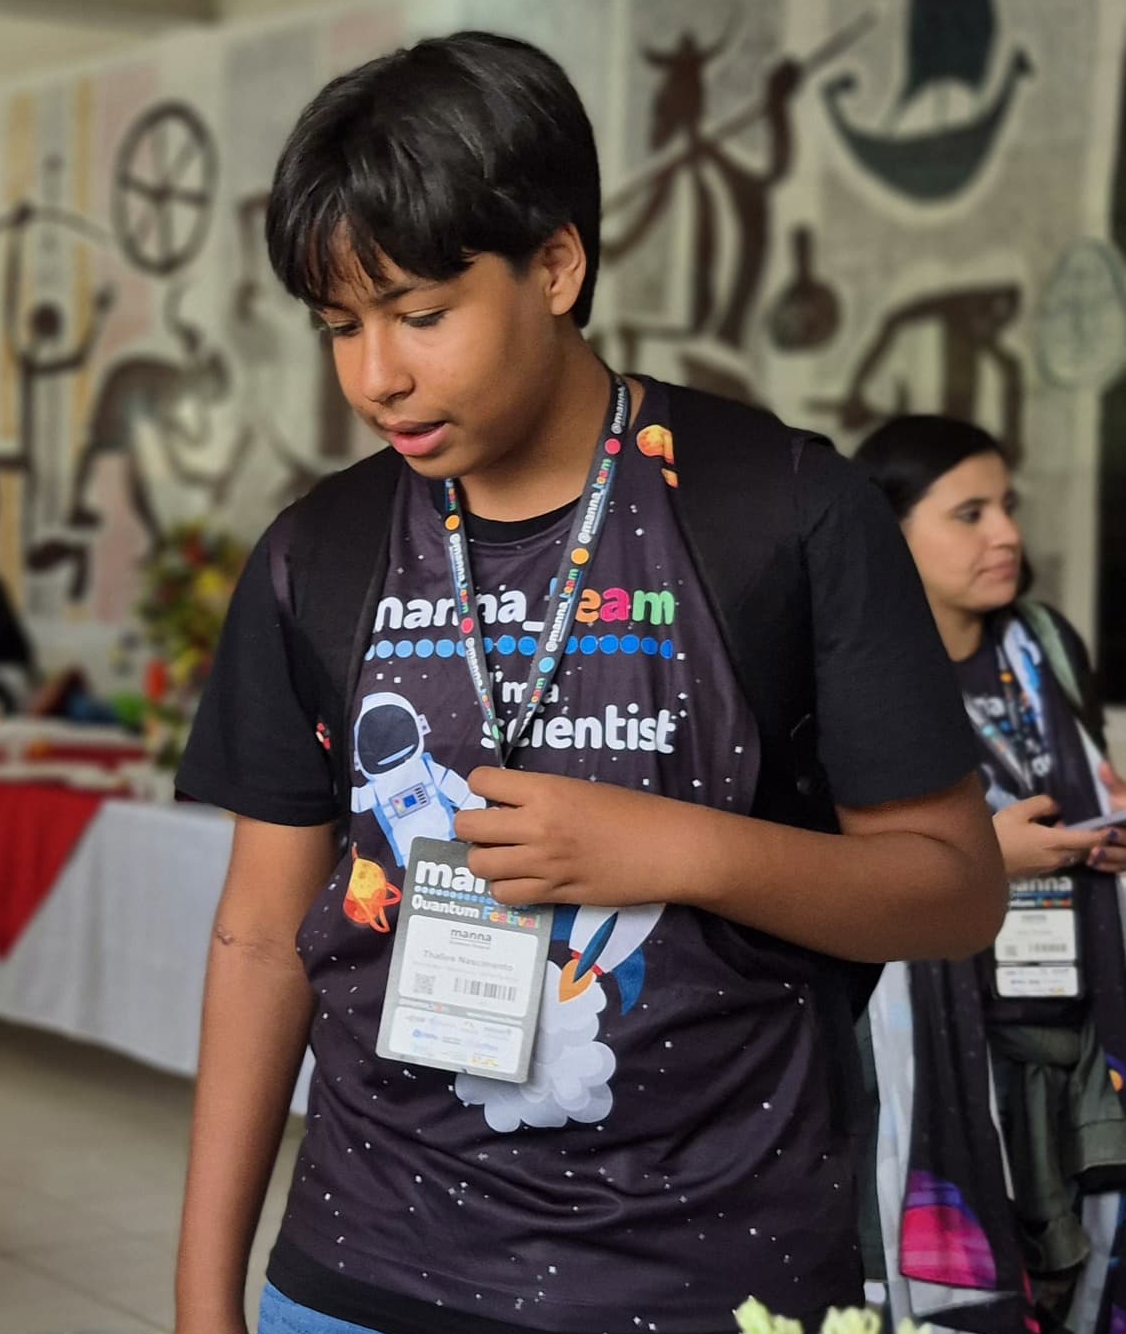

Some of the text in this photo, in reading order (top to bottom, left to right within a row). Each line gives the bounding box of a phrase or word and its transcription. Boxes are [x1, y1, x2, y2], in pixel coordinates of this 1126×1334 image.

[577, 457, 612, 544] @manna_team
[449, 533, 469, 614] @manna_team
[545, 568, 580, 653] @manna_team
[411, 894, 541, 930] Quantum Festival
[450, 928, 492, 942] manna
